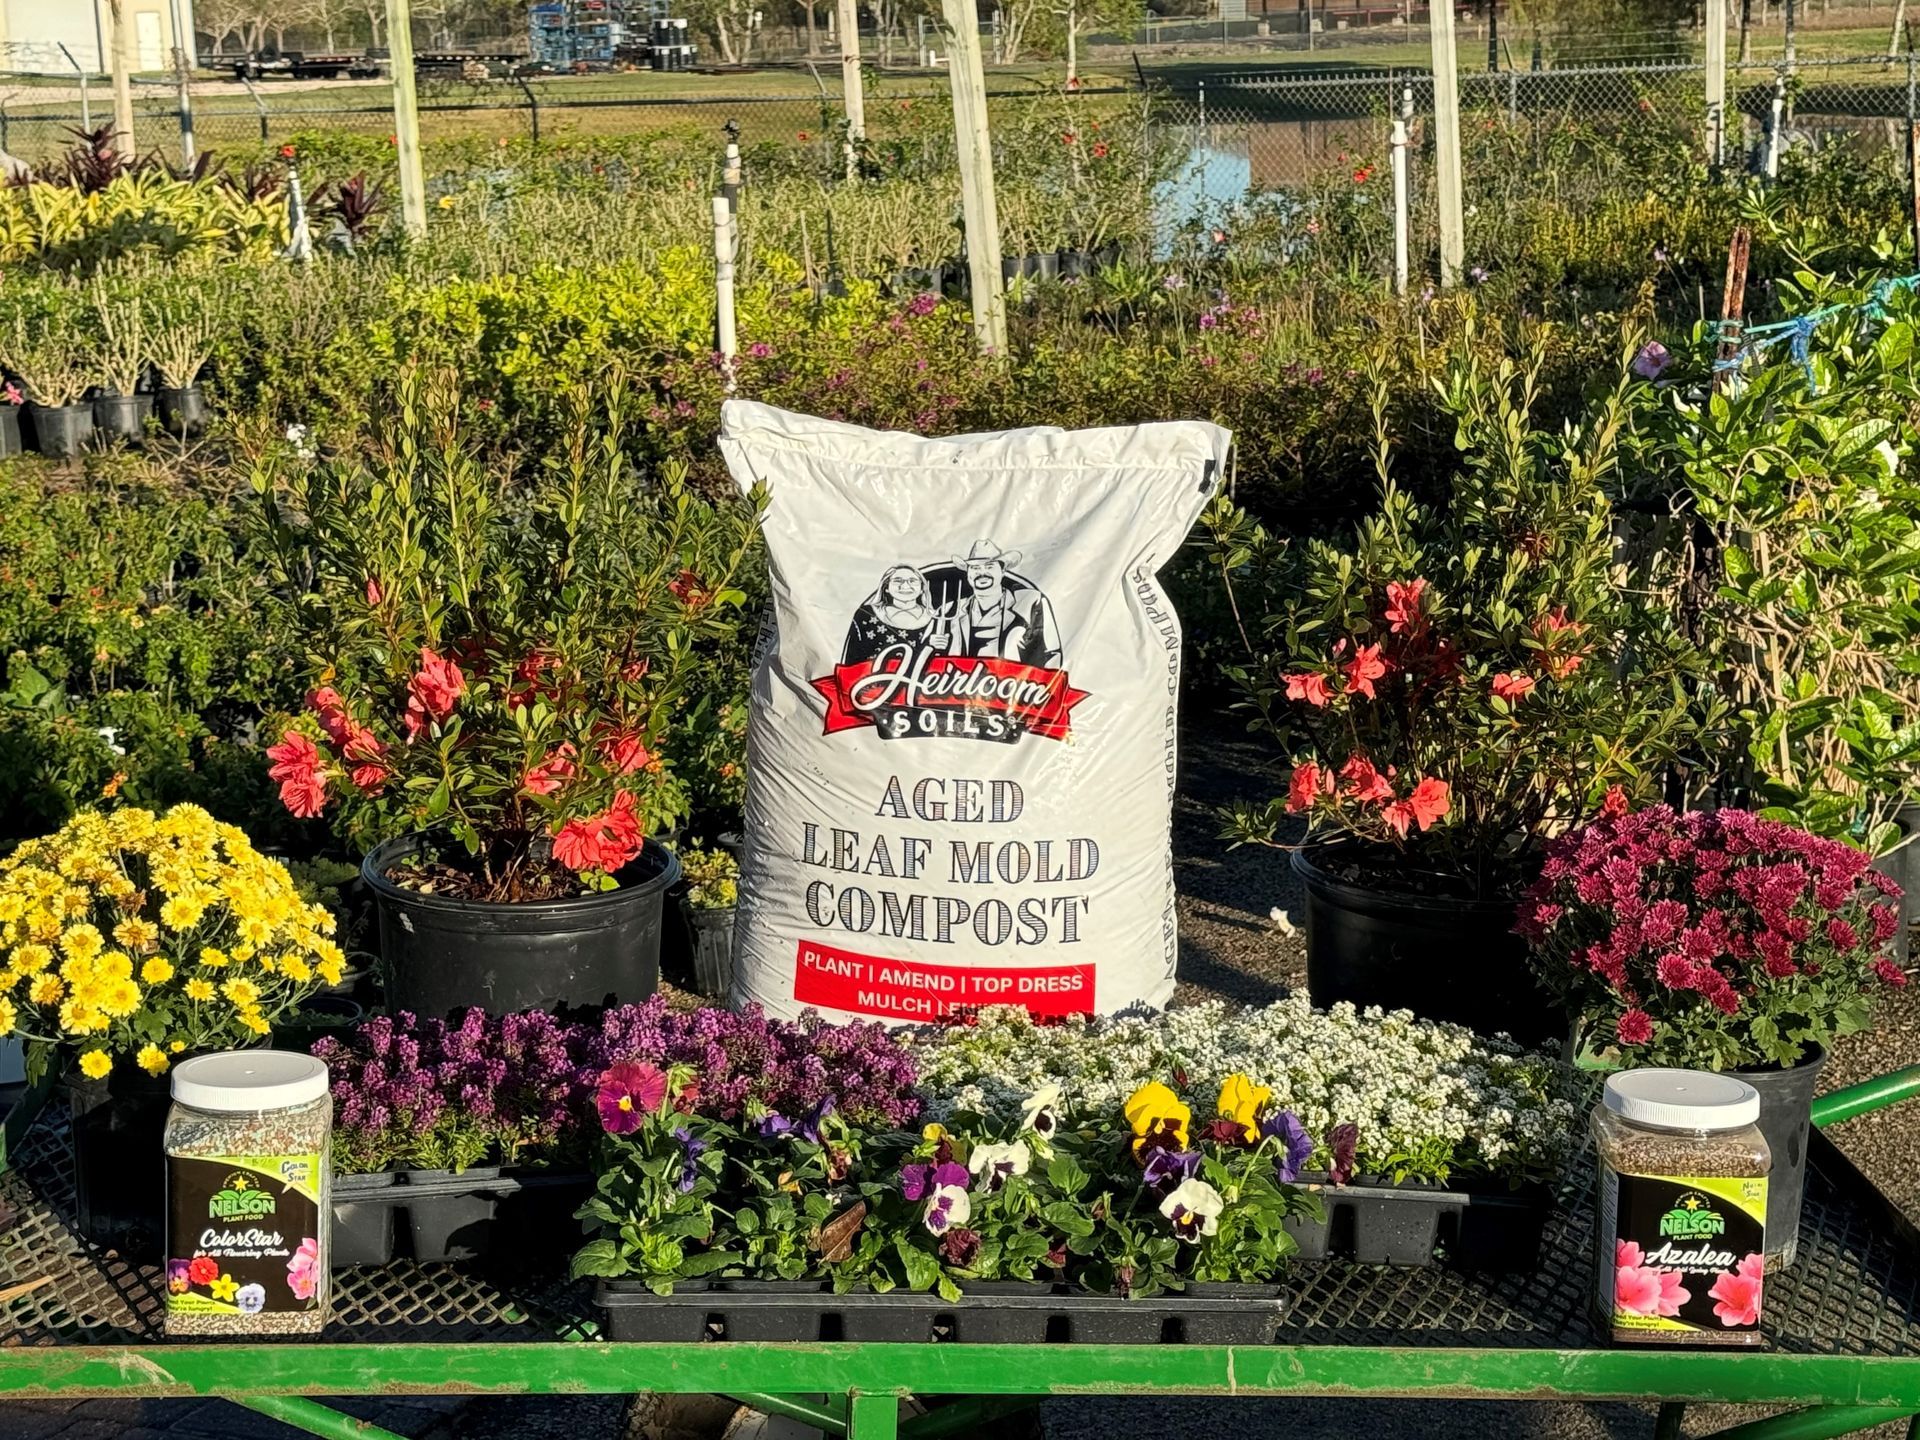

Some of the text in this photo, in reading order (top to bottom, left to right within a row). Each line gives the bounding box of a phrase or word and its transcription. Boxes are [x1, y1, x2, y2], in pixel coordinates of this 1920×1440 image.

[1133, 553, 1179, 696] COMPOS
[850, 643, 1050, 711] Heirloom
[893, 710, 1004, 736] SOILS
[875, 775, 1024, 823] AGED
[801, 821, 1100, 884] LEAF MOLD
[806, 881, 1089, 946] COMPOST
[804, 950, 1083, 993] PLANT AMEND TOP DRESS
[858, 990, 932, 1014] MULCH
[209, 1198, 276, 1219] NELSON
[223, 1215, 244, 1223] PLANT
[200, 1228, 284, 1248] ColorStar
[1660, 1217, 1725, 1237] NELSON
[1645, 1241, 1736, 1266] Azalea
